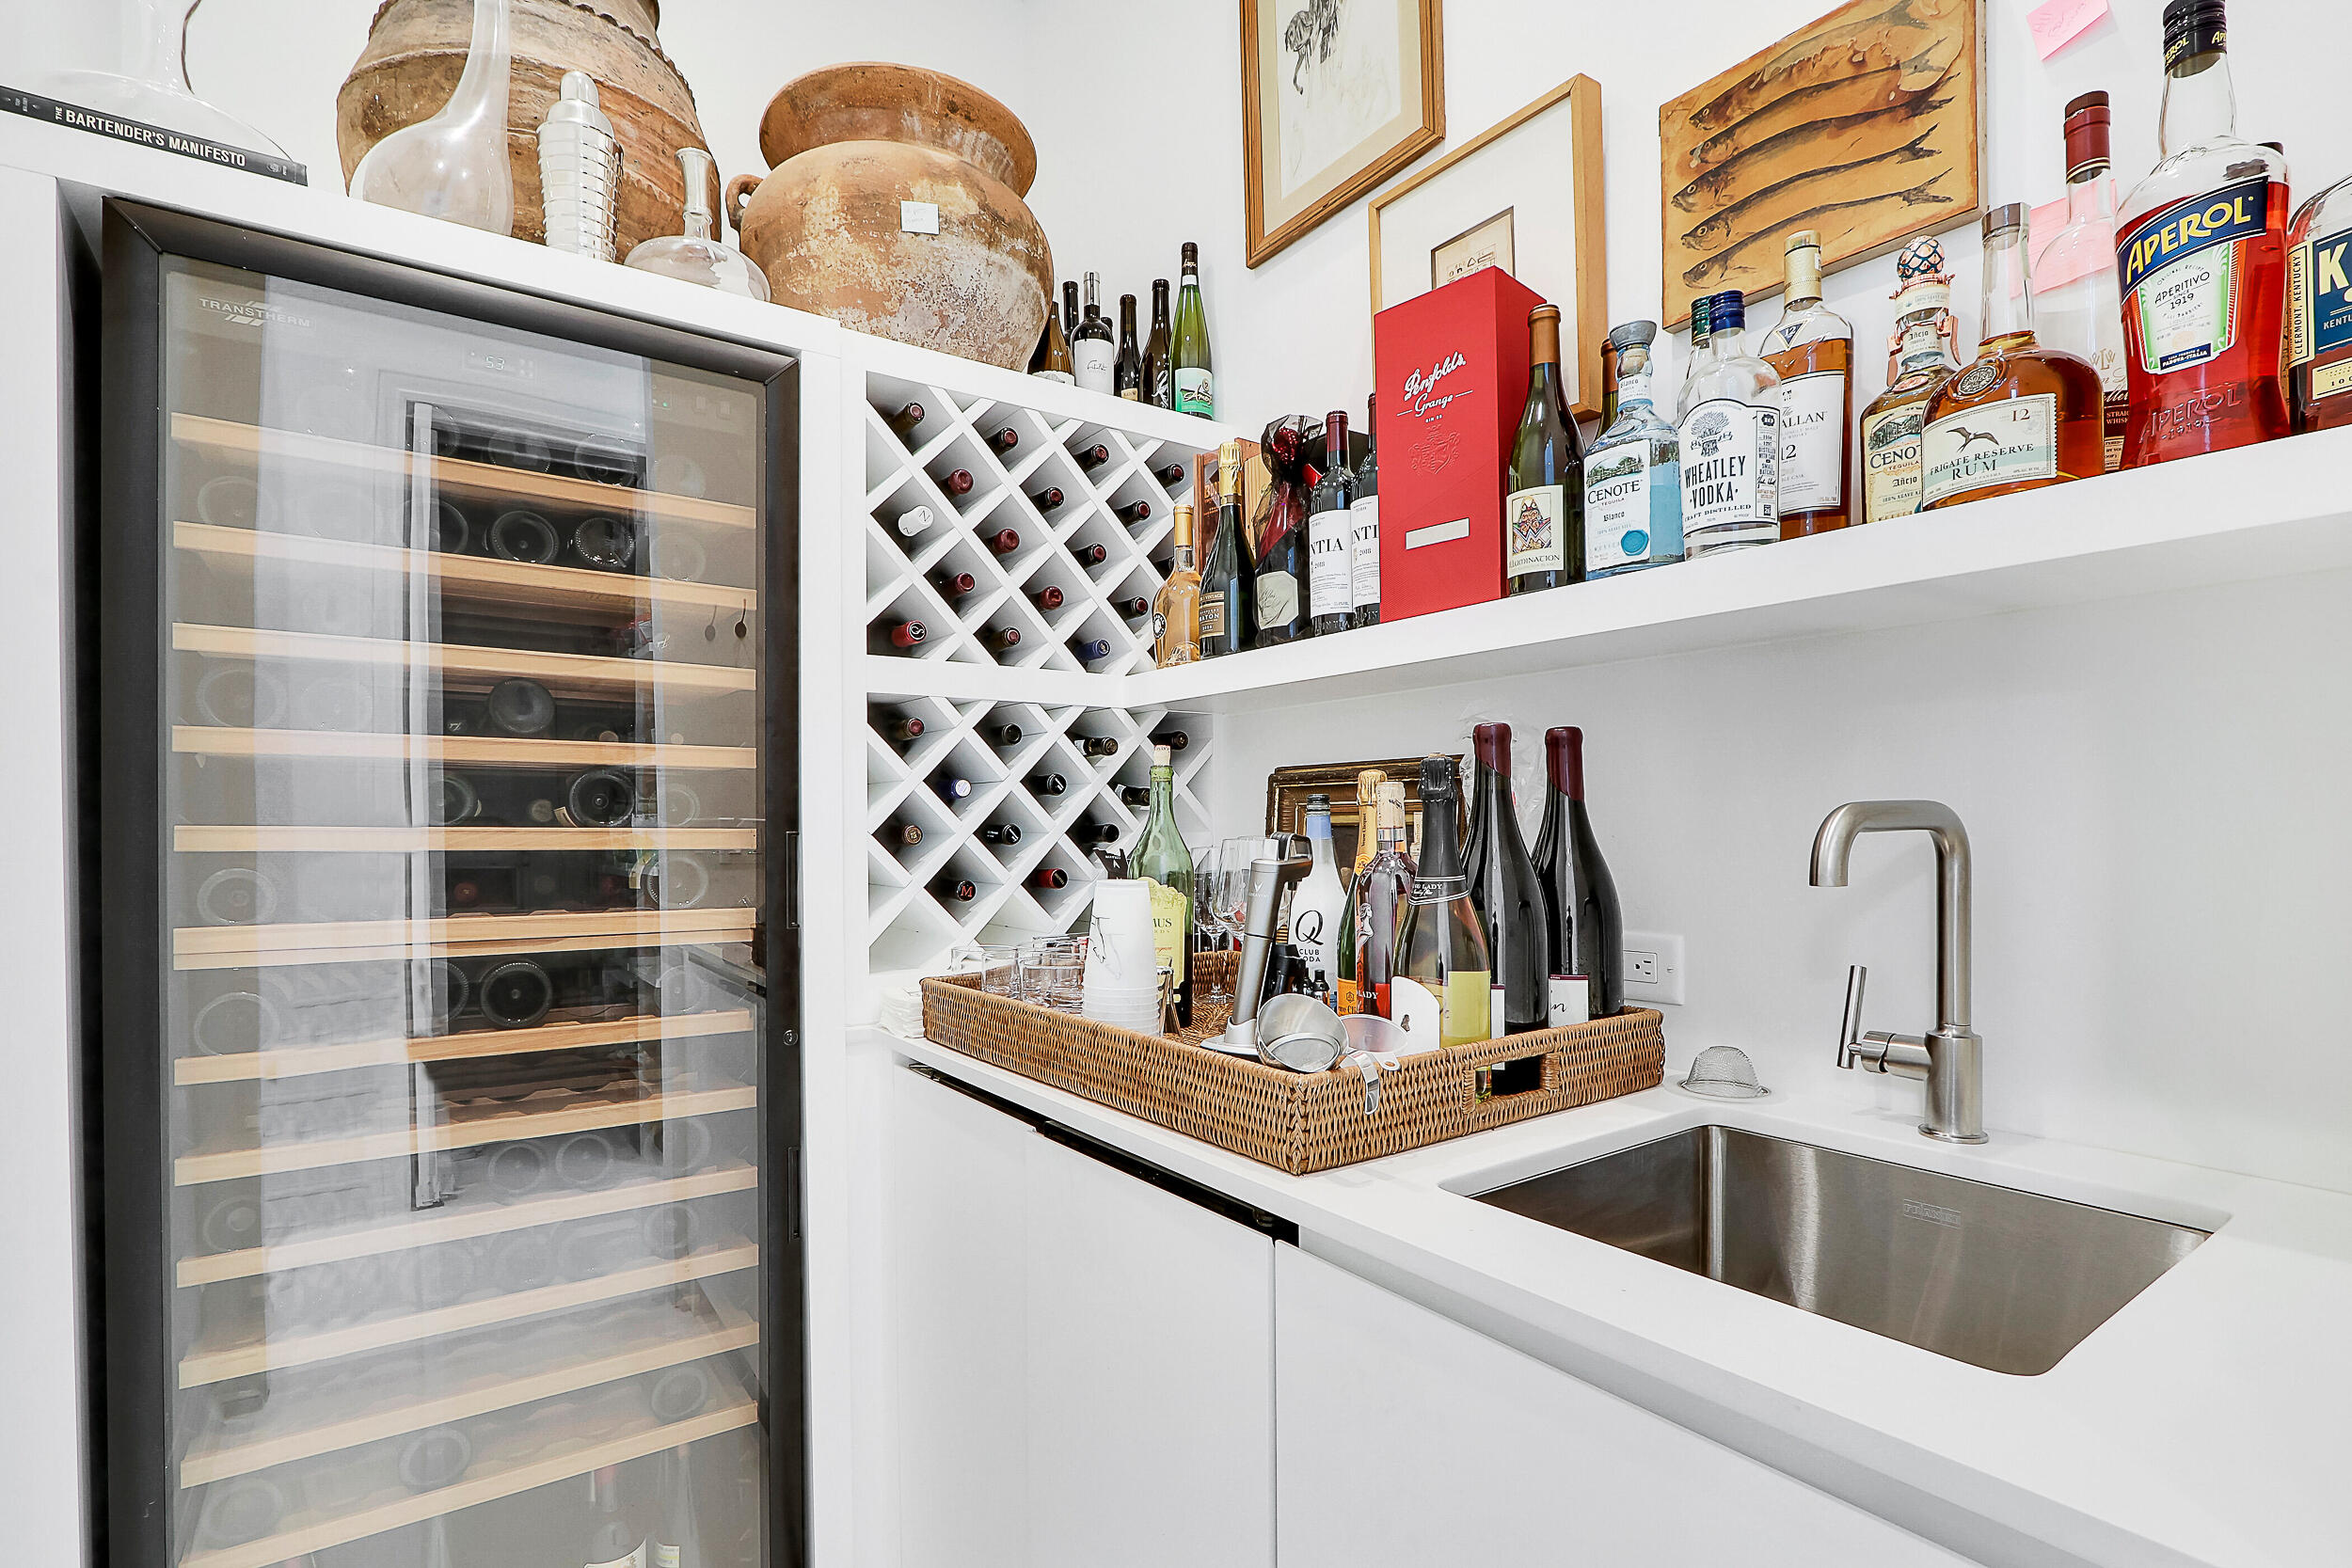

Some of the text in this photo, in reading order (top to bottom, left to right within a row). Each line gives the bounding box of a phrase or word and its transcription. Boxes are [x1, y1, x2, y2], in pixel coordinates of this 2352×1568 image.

[66, 109, 246, 167] BARTENDER'S MANIFESTO
[2126, 195, 2252, 286] APEROL
[2154, 271, 2210, 305] APERITIVO
[2173, 289, 2190, 300] SINCE
[2169, 293, 2195, 310] 1919
[2293, 255, 2303, 355] CLERMONT, KENTUCKY
[199, 298, 310, 327] TRANSTHERM
[485, 356, 505, 371] 53
[1414, 392, 1454, 418] Grange
[2012, 408, 2031, 422] 12
[2138, 387, 2243, 444] APEROL
[1781, 444, 1797, 461] 12
[1930, 443, 2035, 476] FRIGATE RESERVE
[1684, 455, 1746, 489] WHEATLEY
[1887, 460, 1919, 471] TEQUILA
[1952, 459, 1997, 481] RUM
[1204, 481, 1220, 499] BOO
[1892, 476, 1918, 488] Añejo
[1587, 480, 1641, 504] CENOTE
[1692, 481, 1734, 509] VODKA
[1601, 498, 1625, 507] TEQUILA
[1704, 503, 1752, 515] DISTILLED
[1602, 511, 1626, 522] Blanco
[1359, 547, 1372, 557] 2018
[960, 885, 974, 898] M
[1422, 882, 1443, 891] LADY
[1295, 910, 1325, 946] Q
[1358, 990, 1379, 1000] LADY
